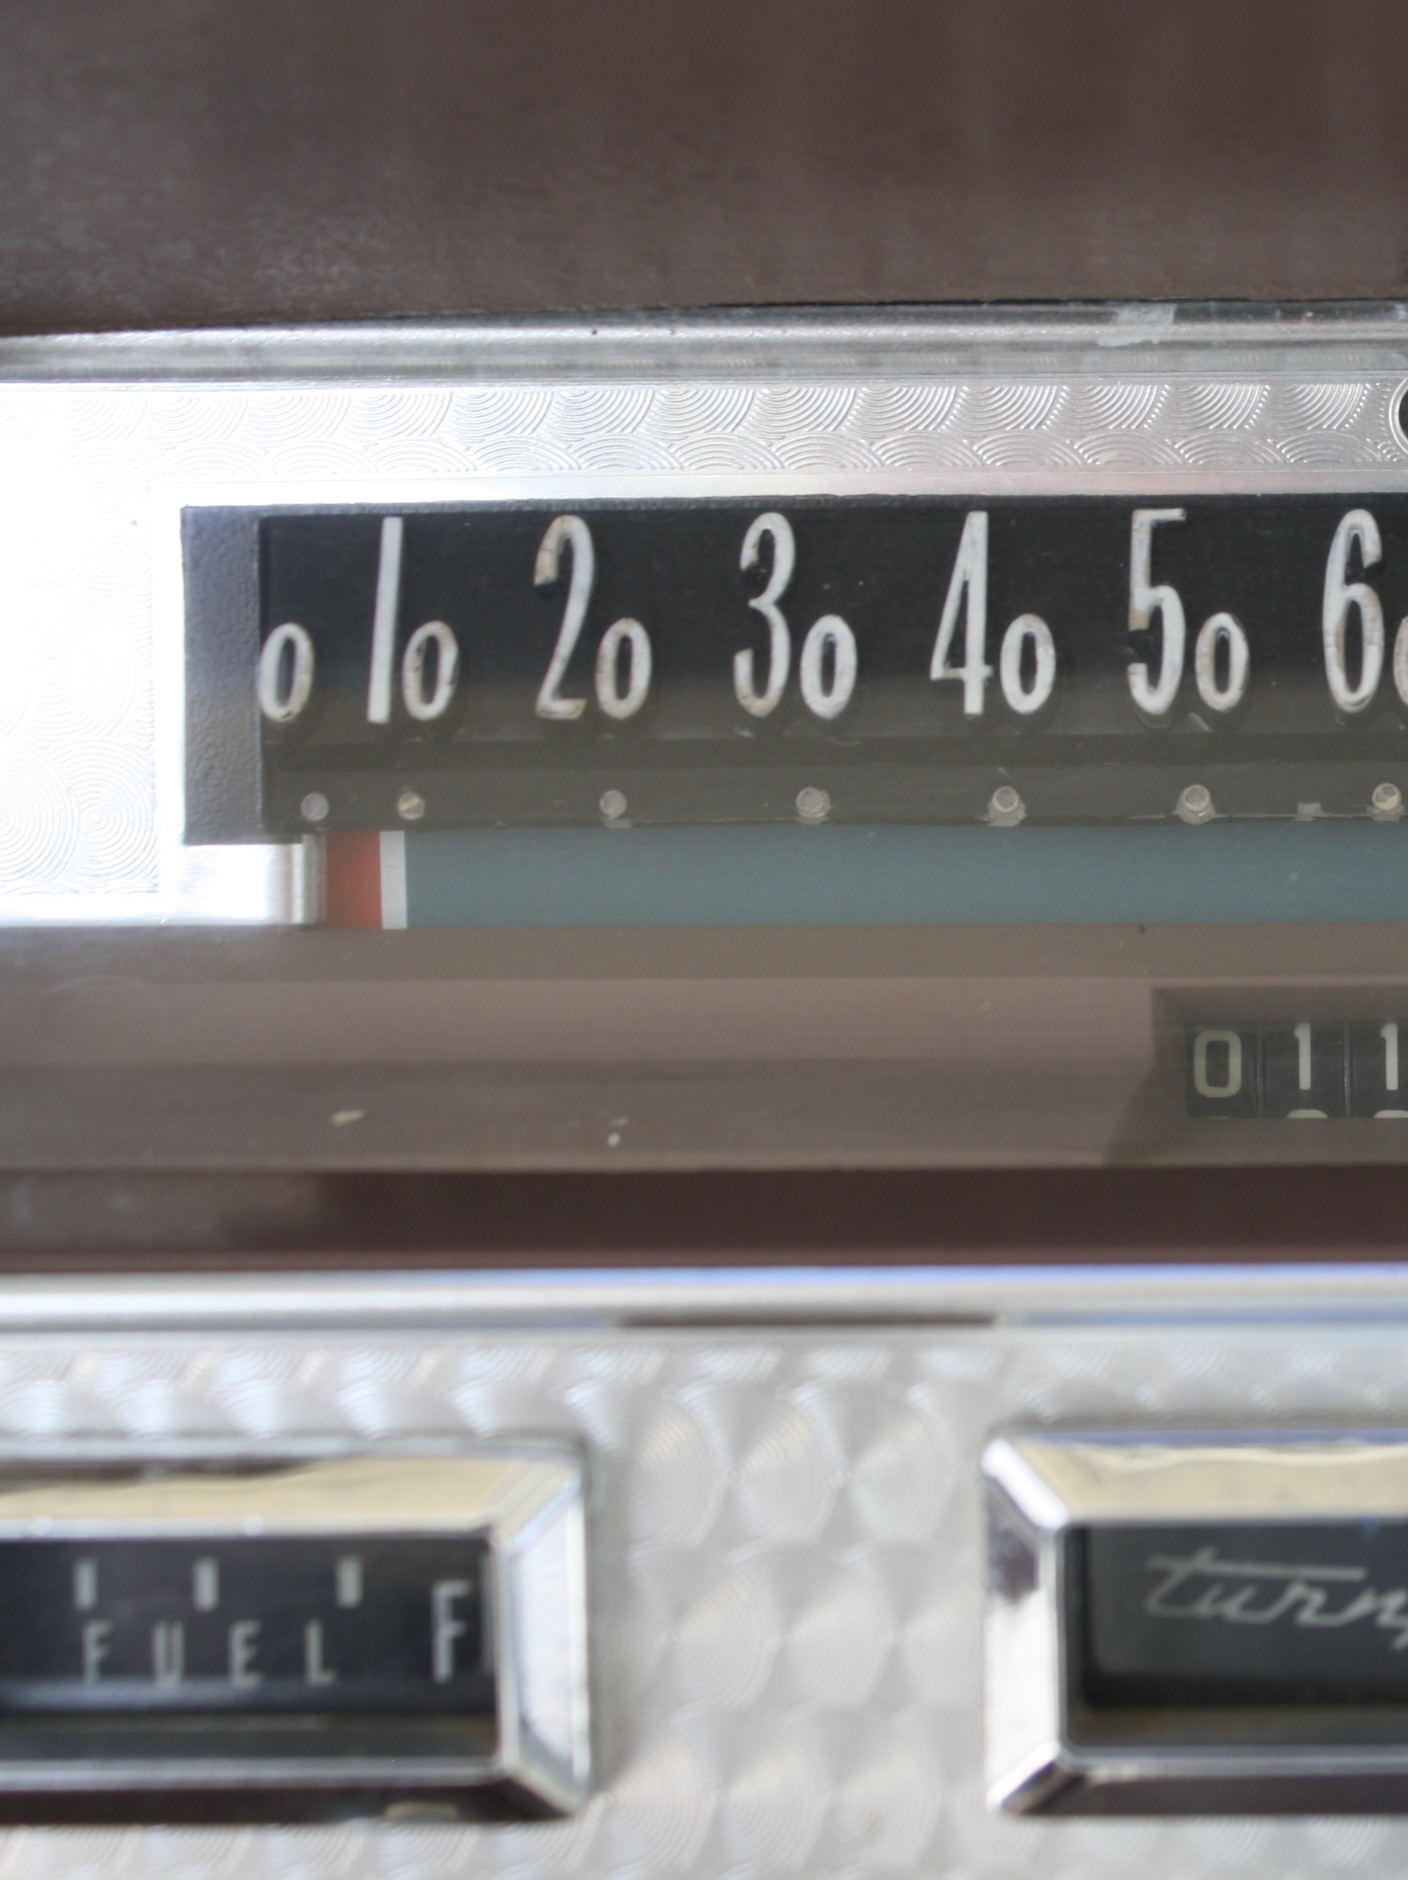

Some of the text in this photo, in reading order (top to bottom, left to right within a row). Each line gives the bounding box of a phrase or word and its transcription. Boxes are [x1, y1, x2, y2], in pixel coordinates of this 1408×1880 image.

[366, 516, 460, 724] 10
[533, 514, 653, 720] 20
[733, 512, 858, 718] 30
[930, 510, 1056, 716] 40
[1127, 507, 1250, 715] 50
[80, 1619, 337, 1688] FUEL
[431, 1579, 472, 1683] F
